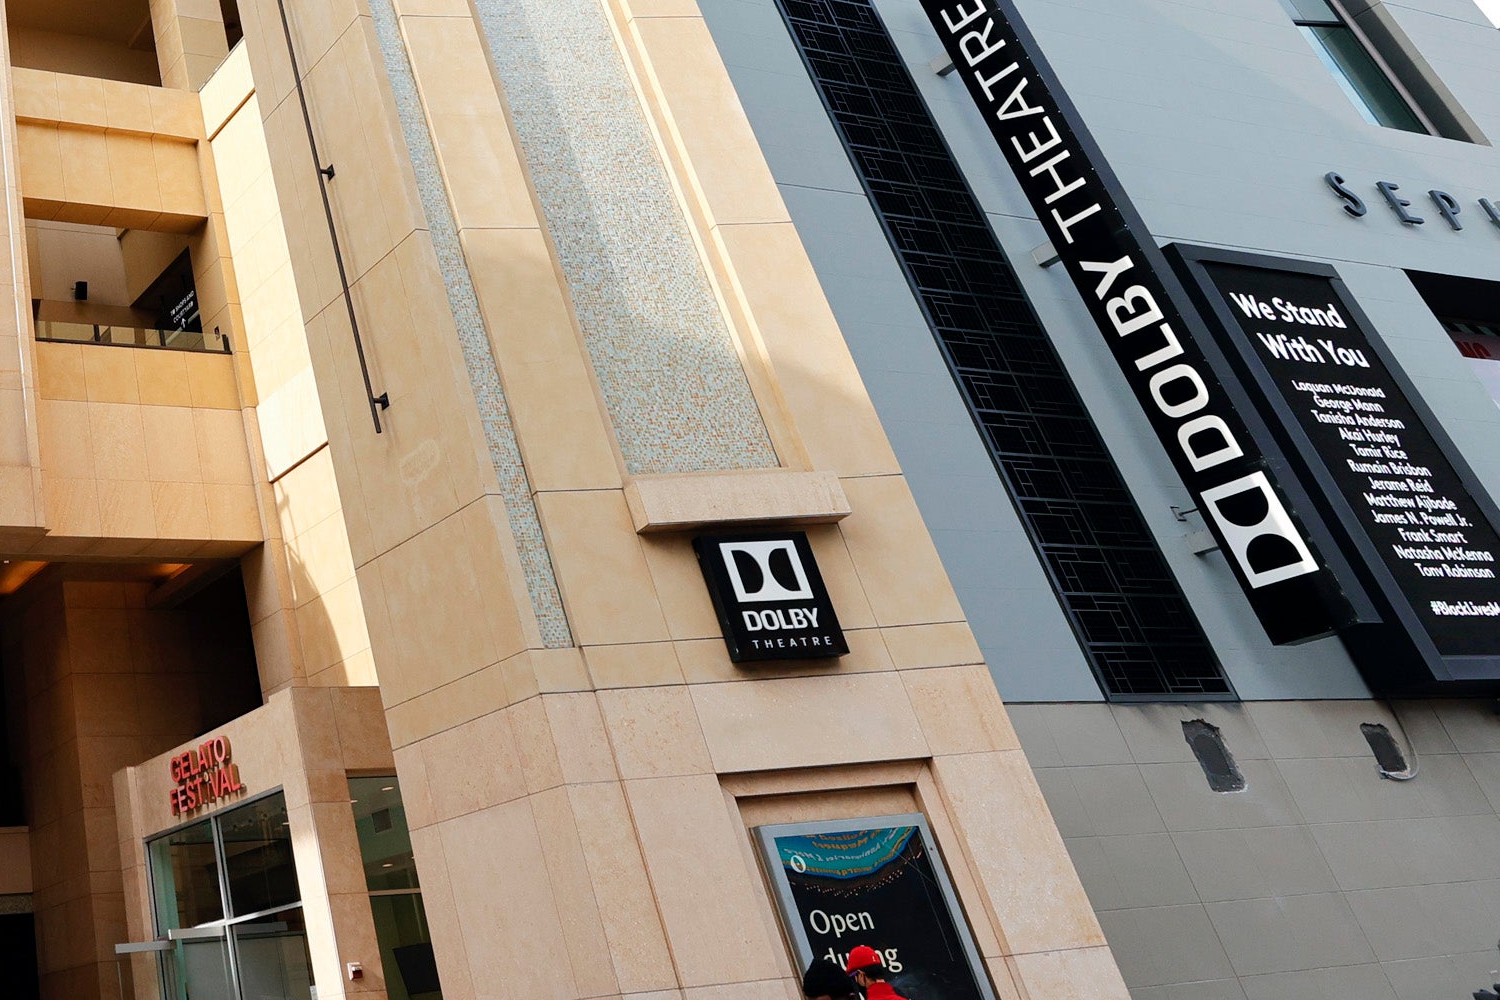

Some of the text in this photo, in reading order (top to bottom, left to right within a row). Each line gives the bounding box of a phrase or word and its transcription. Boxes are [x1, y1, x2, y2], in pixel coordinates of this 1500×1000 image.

[1229, 292, 1347, 328] We Stand
[1256, 332, 1370, 368] With You
[1080, 255, 1244, 473] DOLBY
[1291, 380, 1386, 398] Laquan McDonald
[1313, 395, 1385, 413] George Mann
[1311, 410, 1405, 429] Tanisha Anderson
[1338, 427, 1366, 441] Akai
[1348, 443, 1408, 460] Tamir Rice
[1346, 459, 1433, 477] Rumain Brisbon
[1368, 476, 1434, 493] Jerame Reid
[1363, 492, 1457, 512] Matthew Ajibade
[1371, 509, 1474, 528] James N. Powell Jr.
[1397, 527, 1468, 544] Frank Smart
[1392, 544, 1495, 562] Natasha McKenna
[1441, 563, 1496, 578] Robinson
[742, 607, 819, 631] DOLBY
[752, 636, 832, 649] THEATRE
[170, 736, 231, 783] GELATO
[169, 764, 242, 816] FESTIVAL
[809, 909, 875, 938] Open
